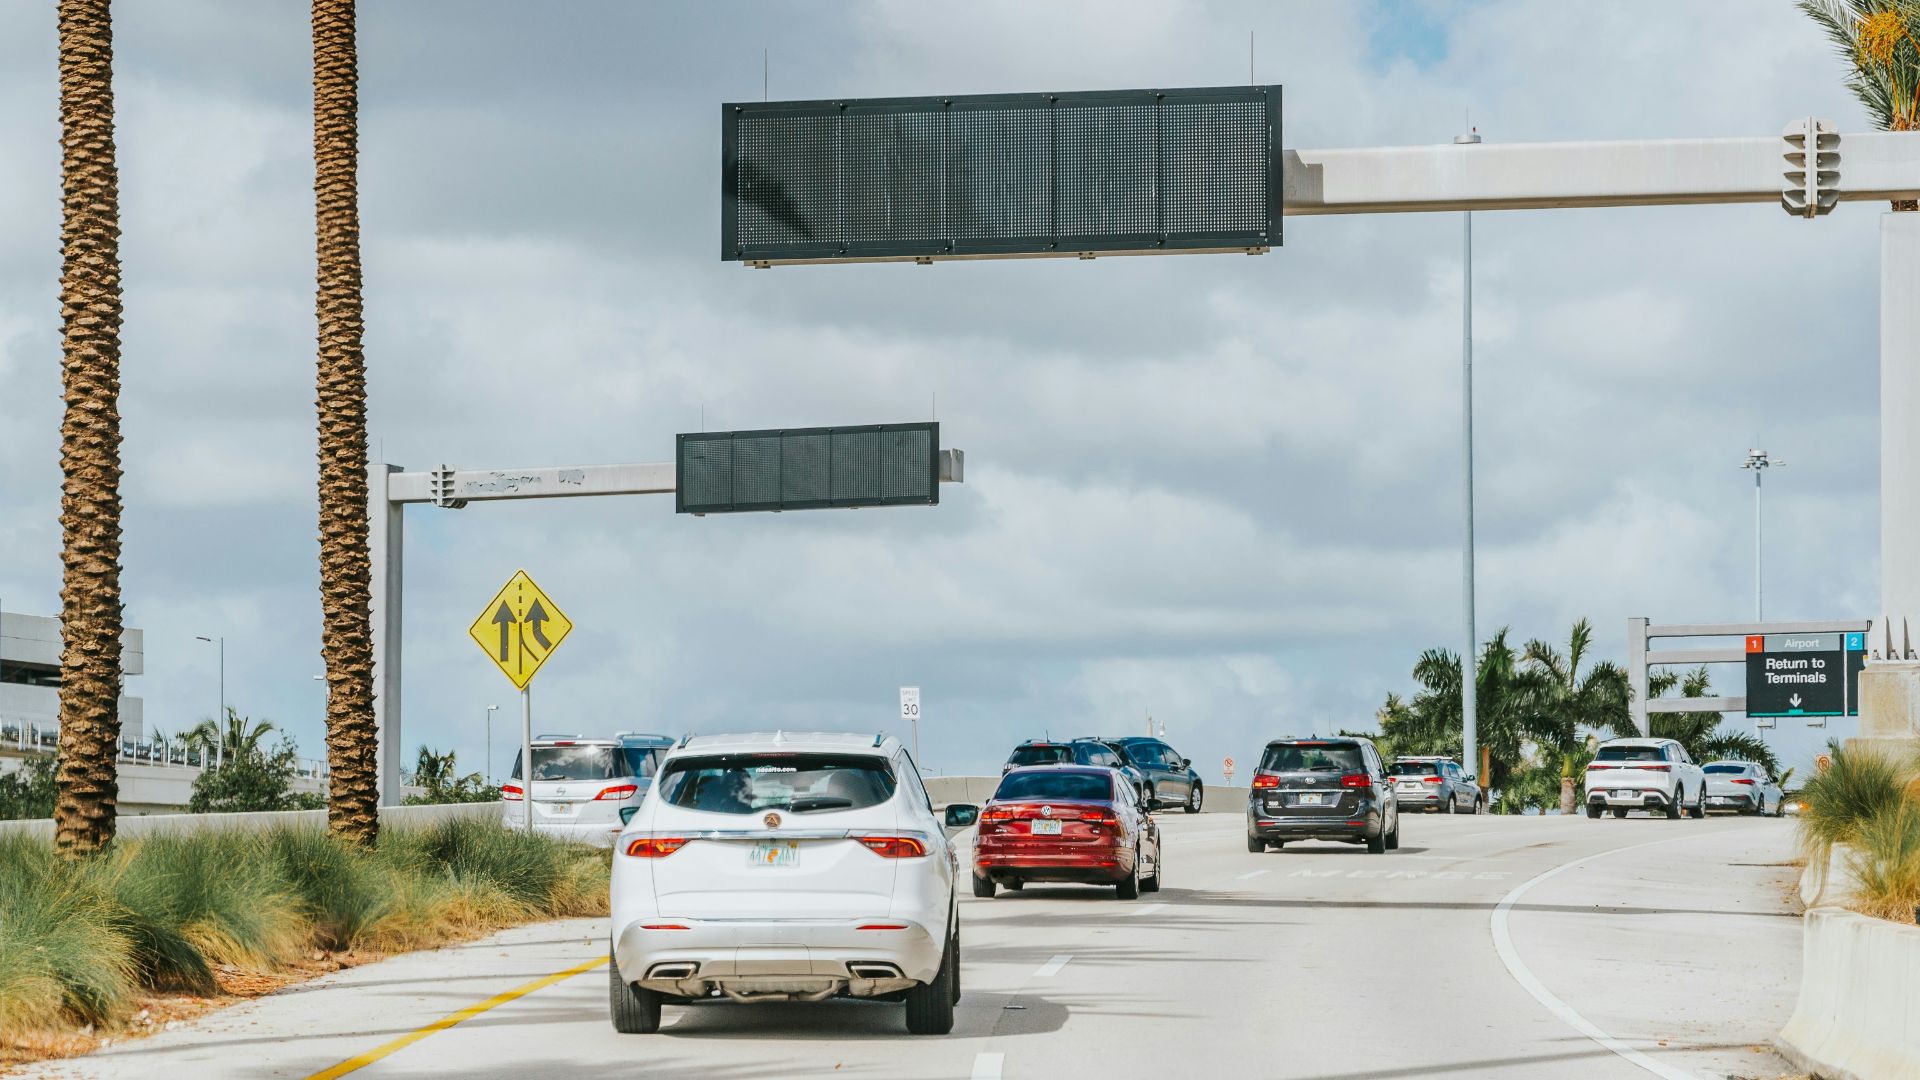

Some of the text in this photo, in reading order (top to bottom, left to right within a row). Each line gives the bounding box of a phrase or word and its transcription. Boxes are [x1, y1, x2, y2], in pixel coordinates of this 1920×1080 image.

[1751, 640, 1757, 649] 1
[1784, 639, 1820, 649] Airport
[1850, 637, 1858, 647] 2
[1765, 658, 1826, 670] Return to
[1764, 671, 1827, 684] Terminals
[903, 703, 919, 716] 30
